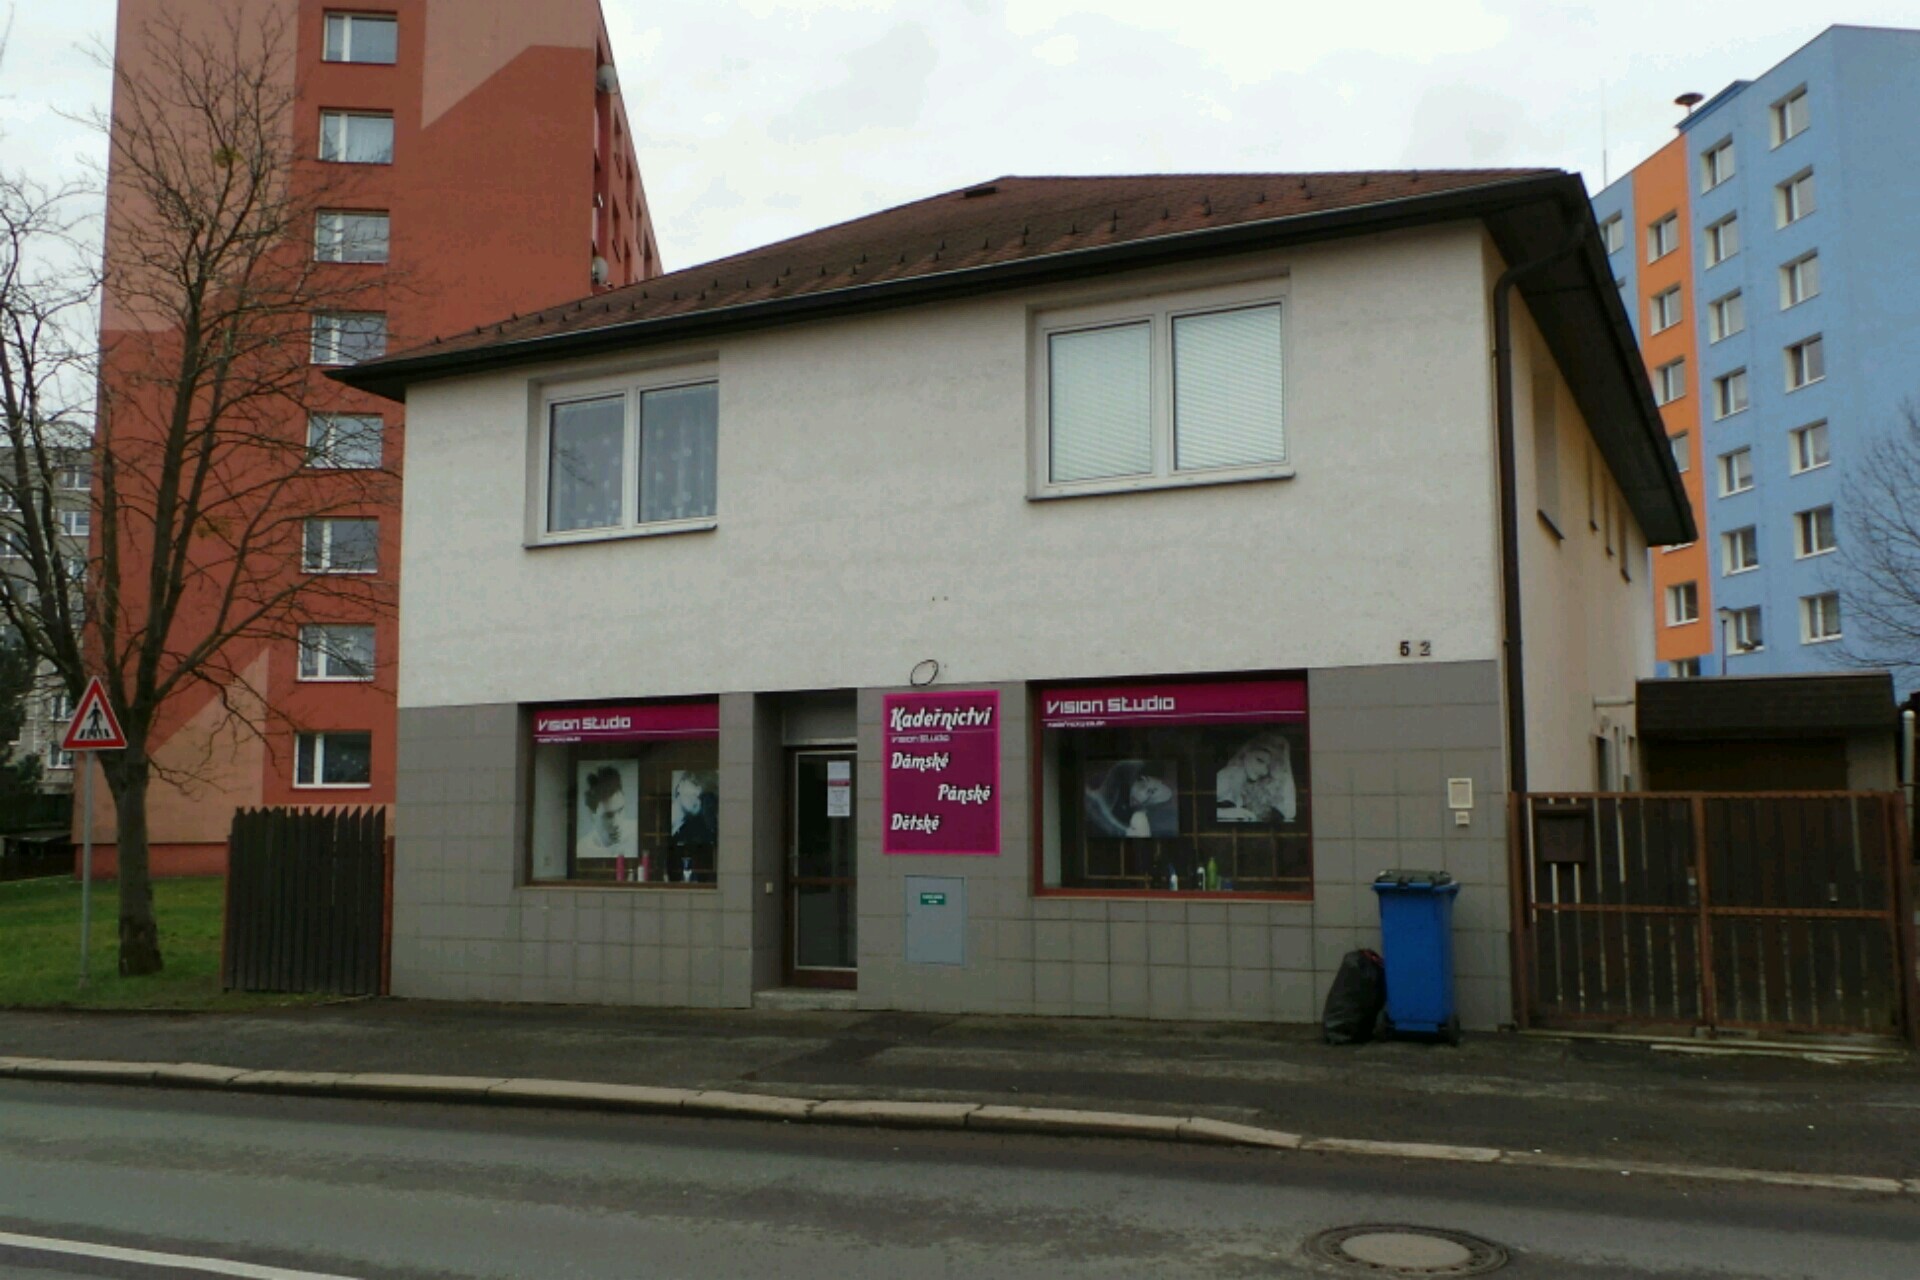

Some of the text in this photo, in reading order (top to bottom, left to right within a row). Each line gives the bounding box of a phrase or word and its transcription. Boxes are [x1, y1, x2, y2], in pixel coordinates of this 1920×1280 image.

[1107, 695, 1175, 712] Studio
[582, 715, 631, 730] Studio
[890, 706, 992, 731] Kadeřnictví
[891, 751, 950, 772] Dámské
[938, 783, 991, 805] Pánské
[890, 813, 940, 834] Dětské
